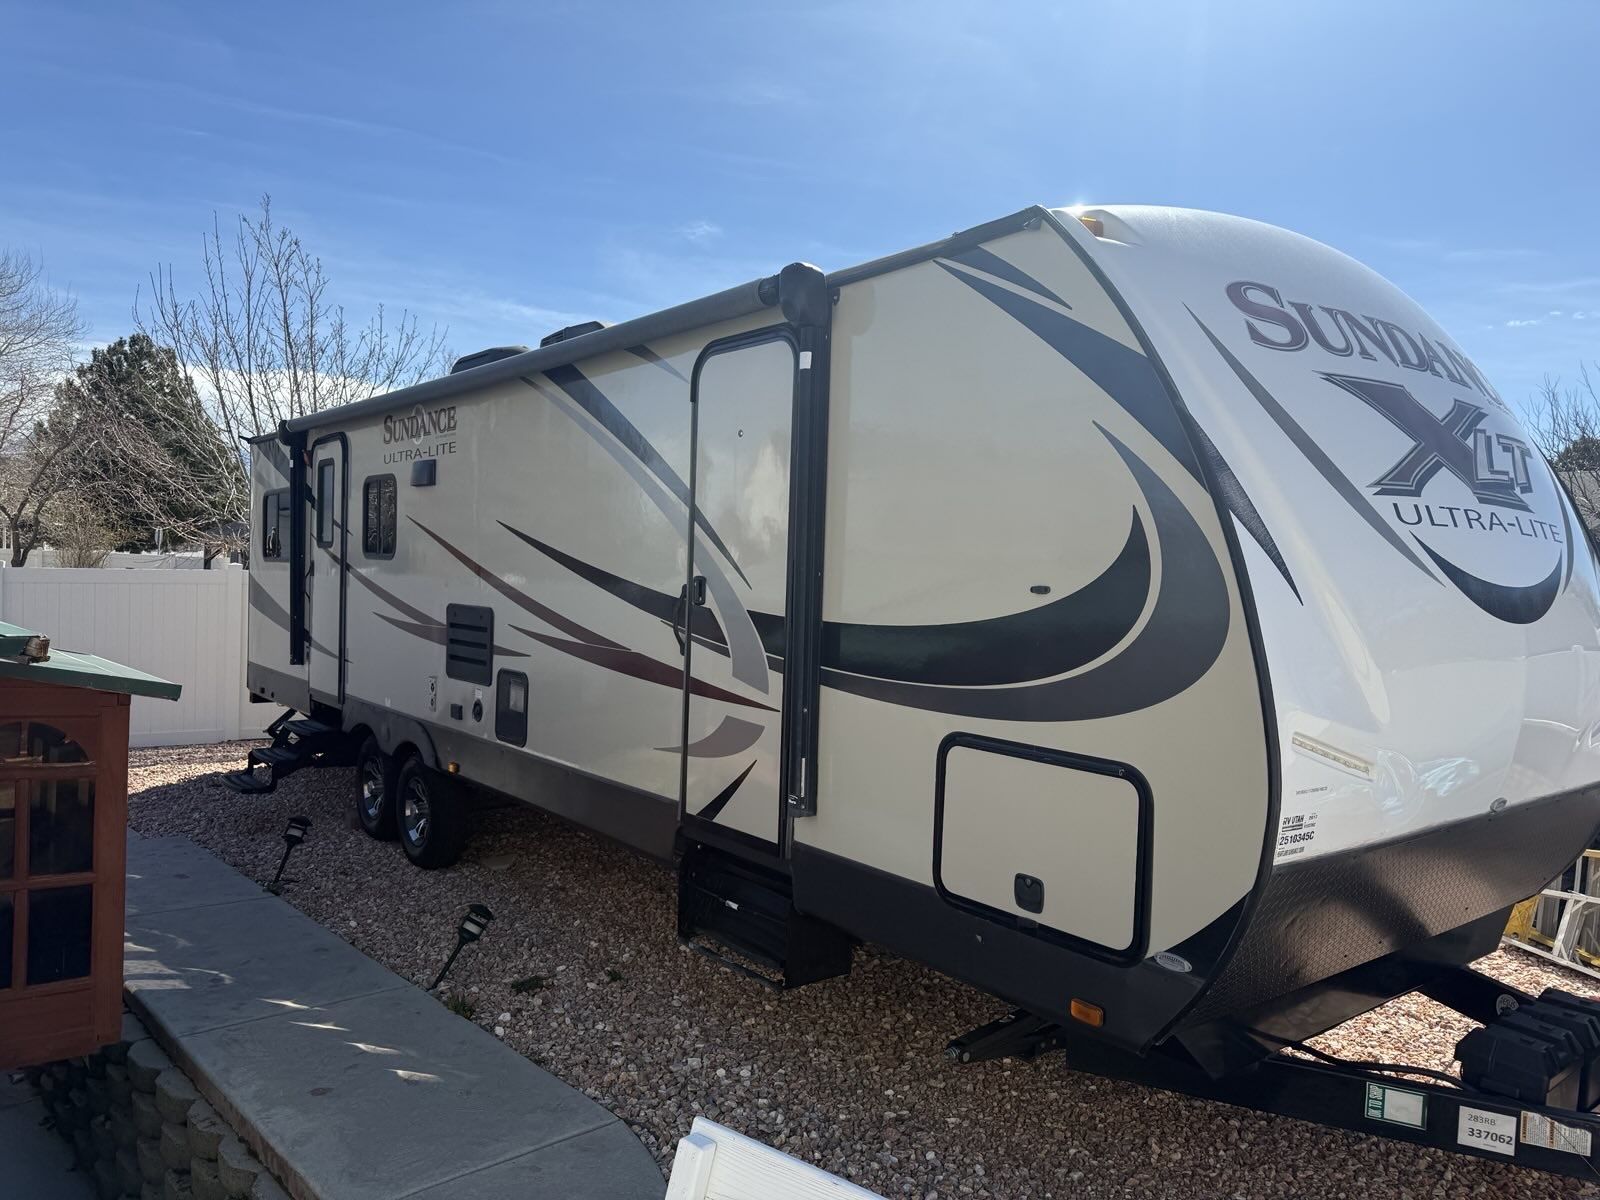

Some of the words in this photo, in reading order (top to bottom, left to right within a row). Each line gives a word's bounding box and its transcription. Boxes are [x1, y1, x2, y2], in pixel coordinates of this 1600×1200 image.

[1225, 280, 1517, 424] SUNDANC
[384, 406, 457, 444] SUNDANCE
[384, 441, 456, 464] ULTRA-LITE
[1312, 370, 1535, 513] XLT
[1393, 502, 1563, 544] ULTRA-LITE
[1292, 814, 1304, 824] UTAH
[1369, 1099, 1383, 1109] TO
[1467, 1127, 1513, 1146] 337062
